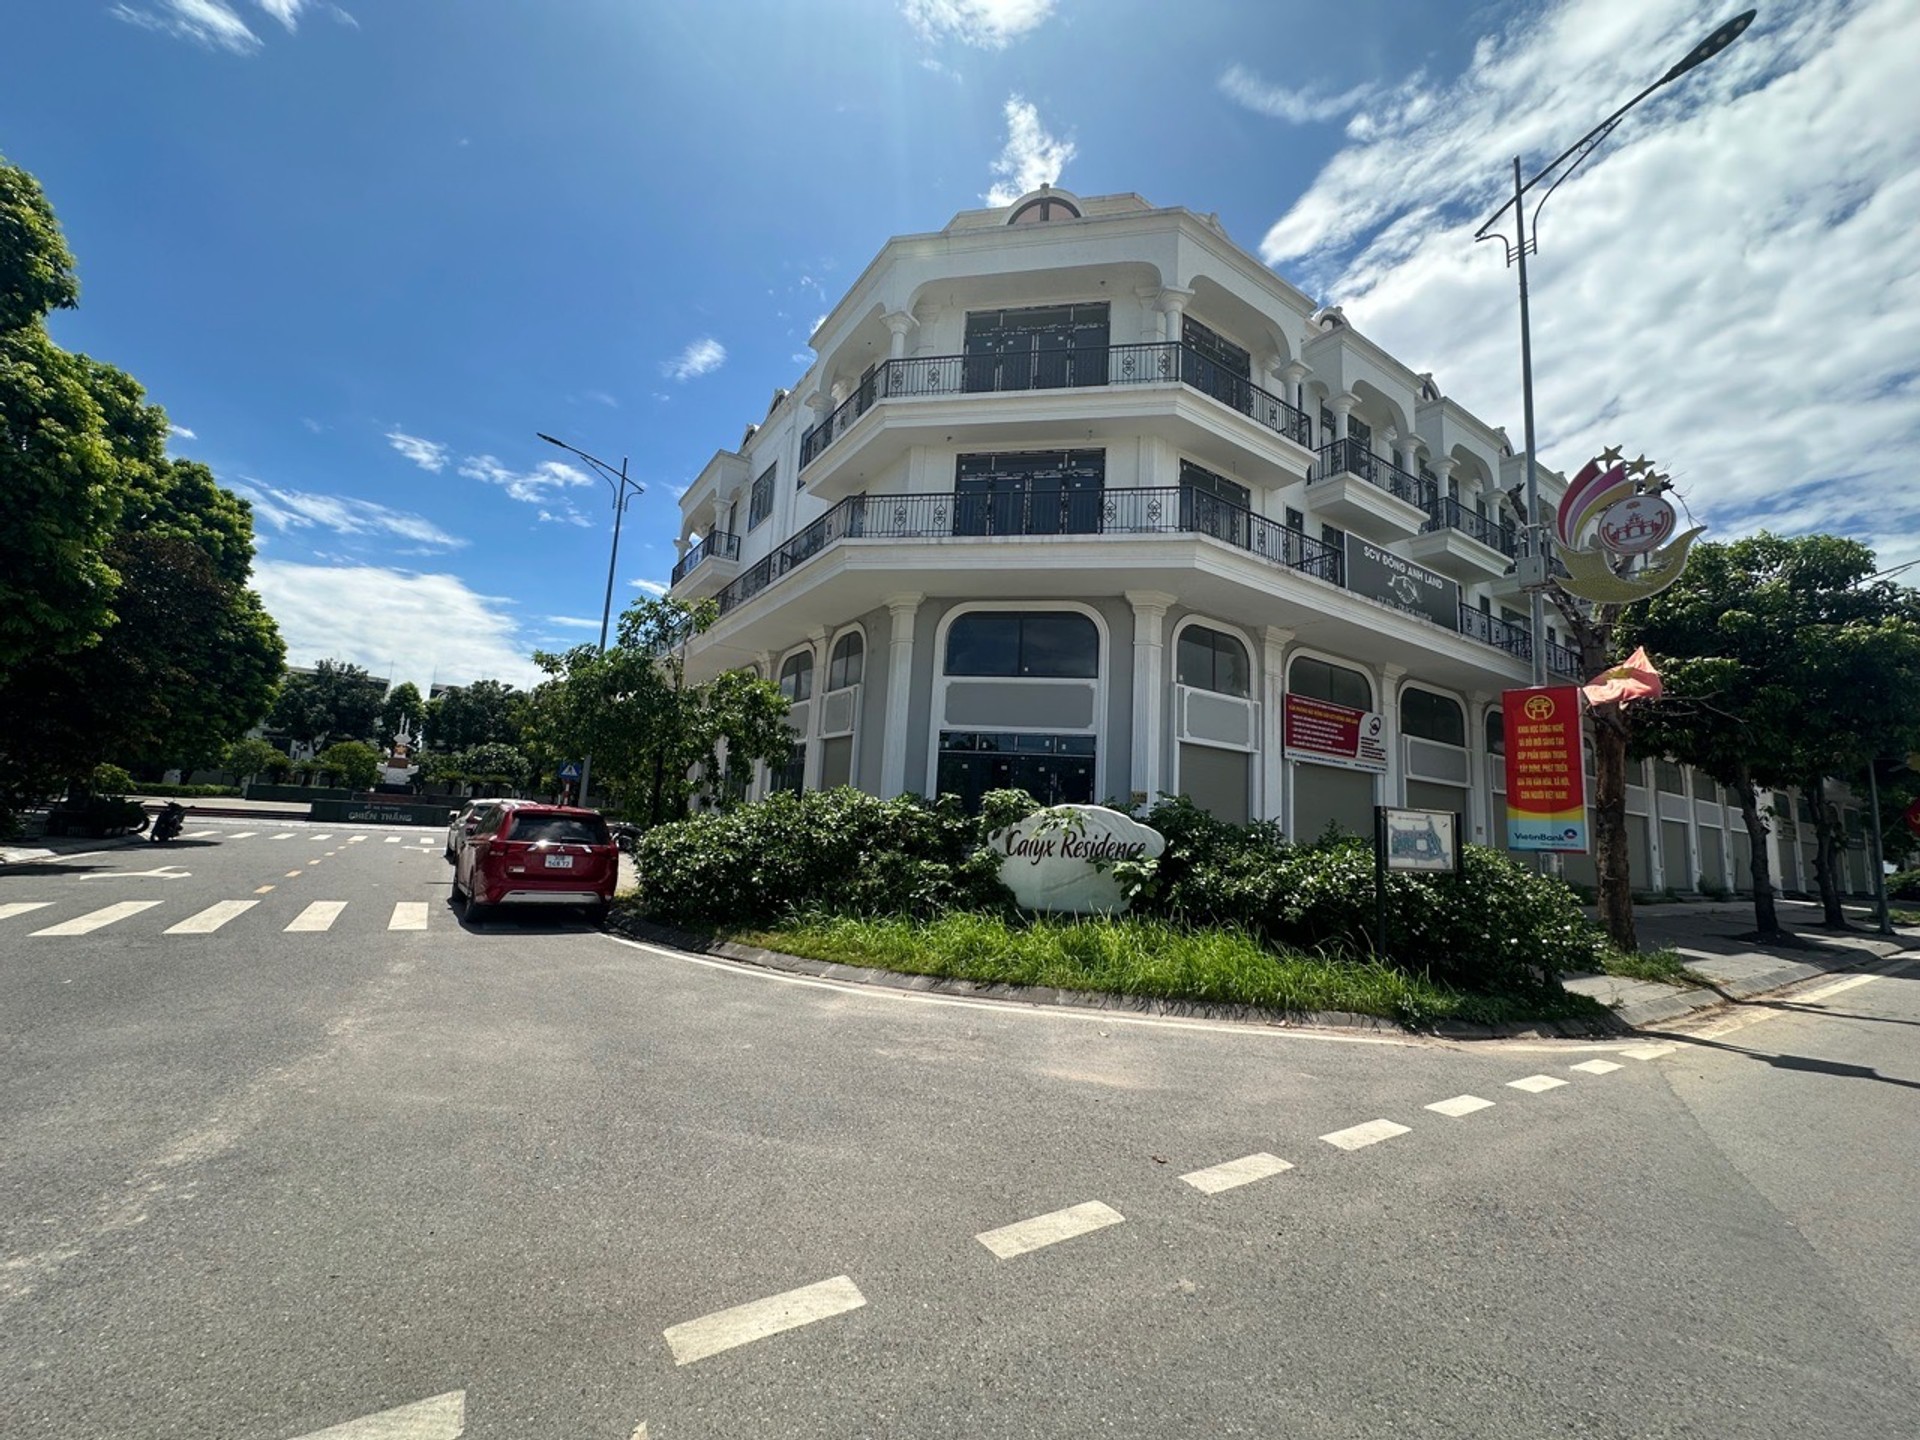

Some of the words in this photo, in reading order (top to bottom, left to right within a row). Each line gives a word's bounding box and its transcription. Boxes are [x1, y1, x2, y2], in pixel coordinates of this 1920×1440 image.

[1364, 546, 1381, 562] SCV
[1382, 555, 1405, 573] ĐÔNG
[1407, 566, 1424, 581] ANH
[1424, 573, 1443, 589] LAND
[1006, 830, 1056, 865] Calyx
[1060, 830, 1146, 858] Residence
[1514, 832, 1564, 841] VietinBank
